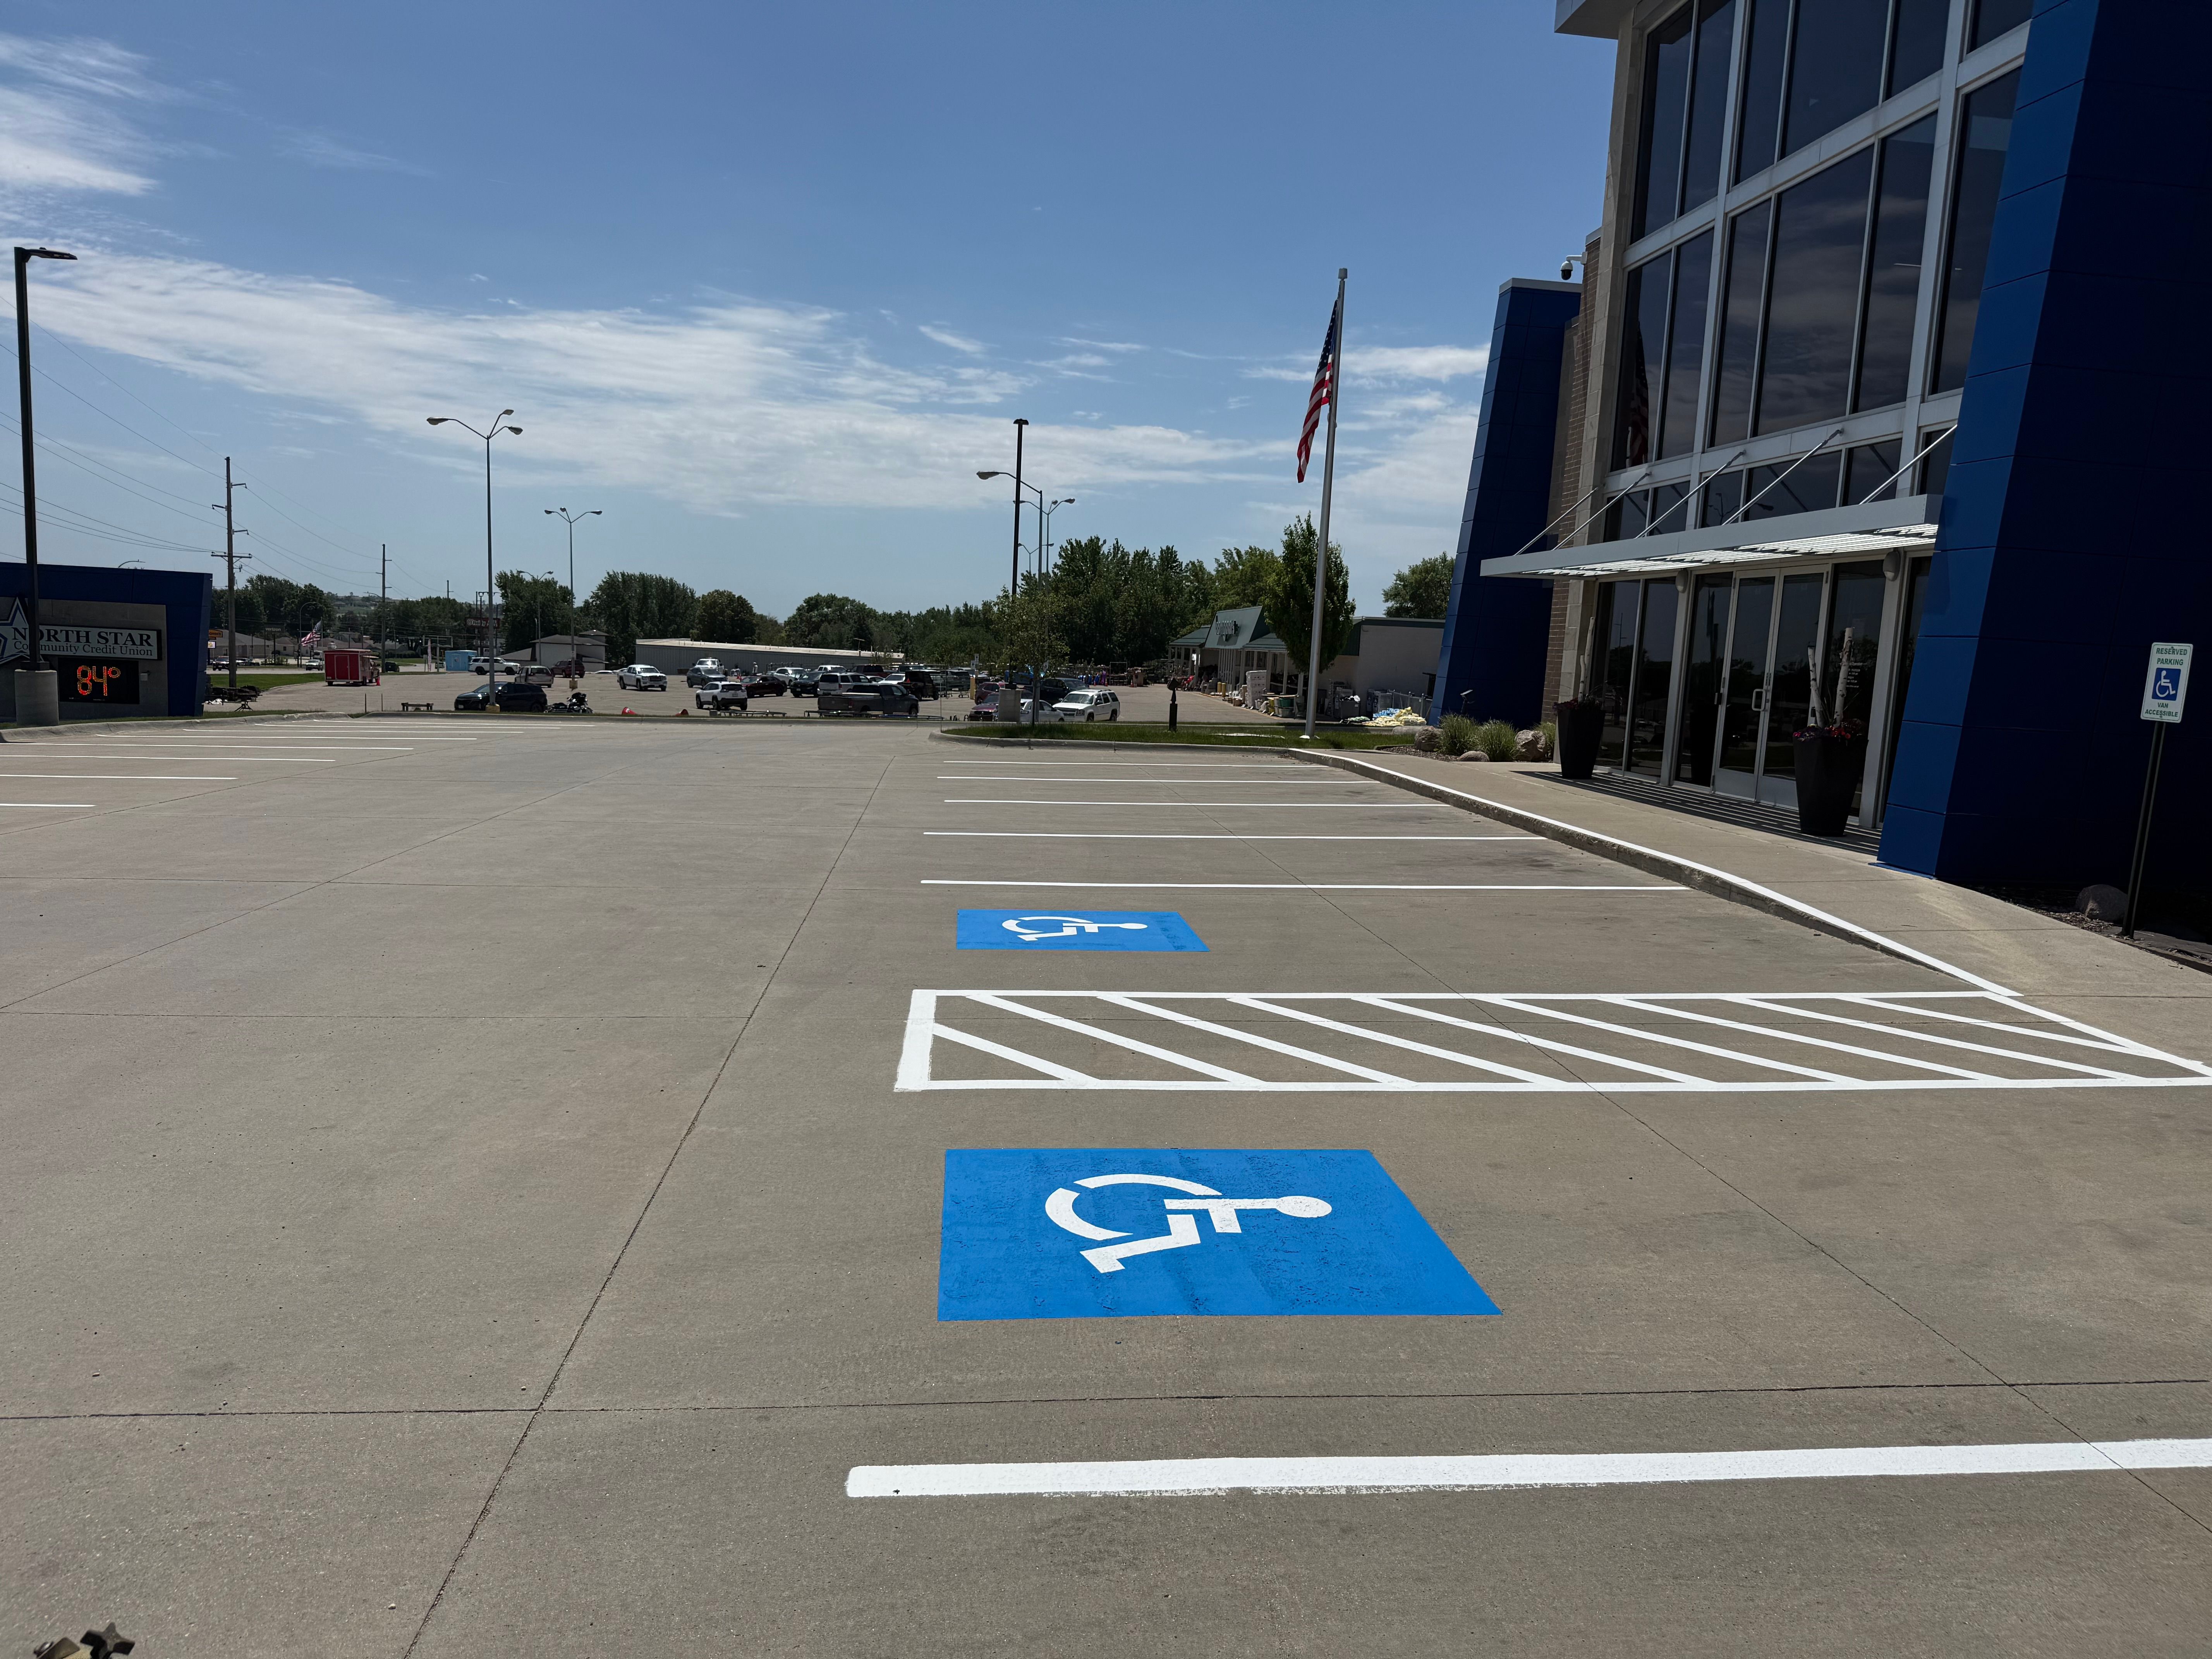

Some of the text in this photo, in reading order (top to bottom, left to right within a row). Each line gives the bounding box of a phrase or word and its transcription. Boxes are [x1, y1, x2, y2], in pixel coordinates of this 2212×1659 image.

[97, 631, 153, 646] STAR
[14, 641, 152, 656] Comunity Credit Union
